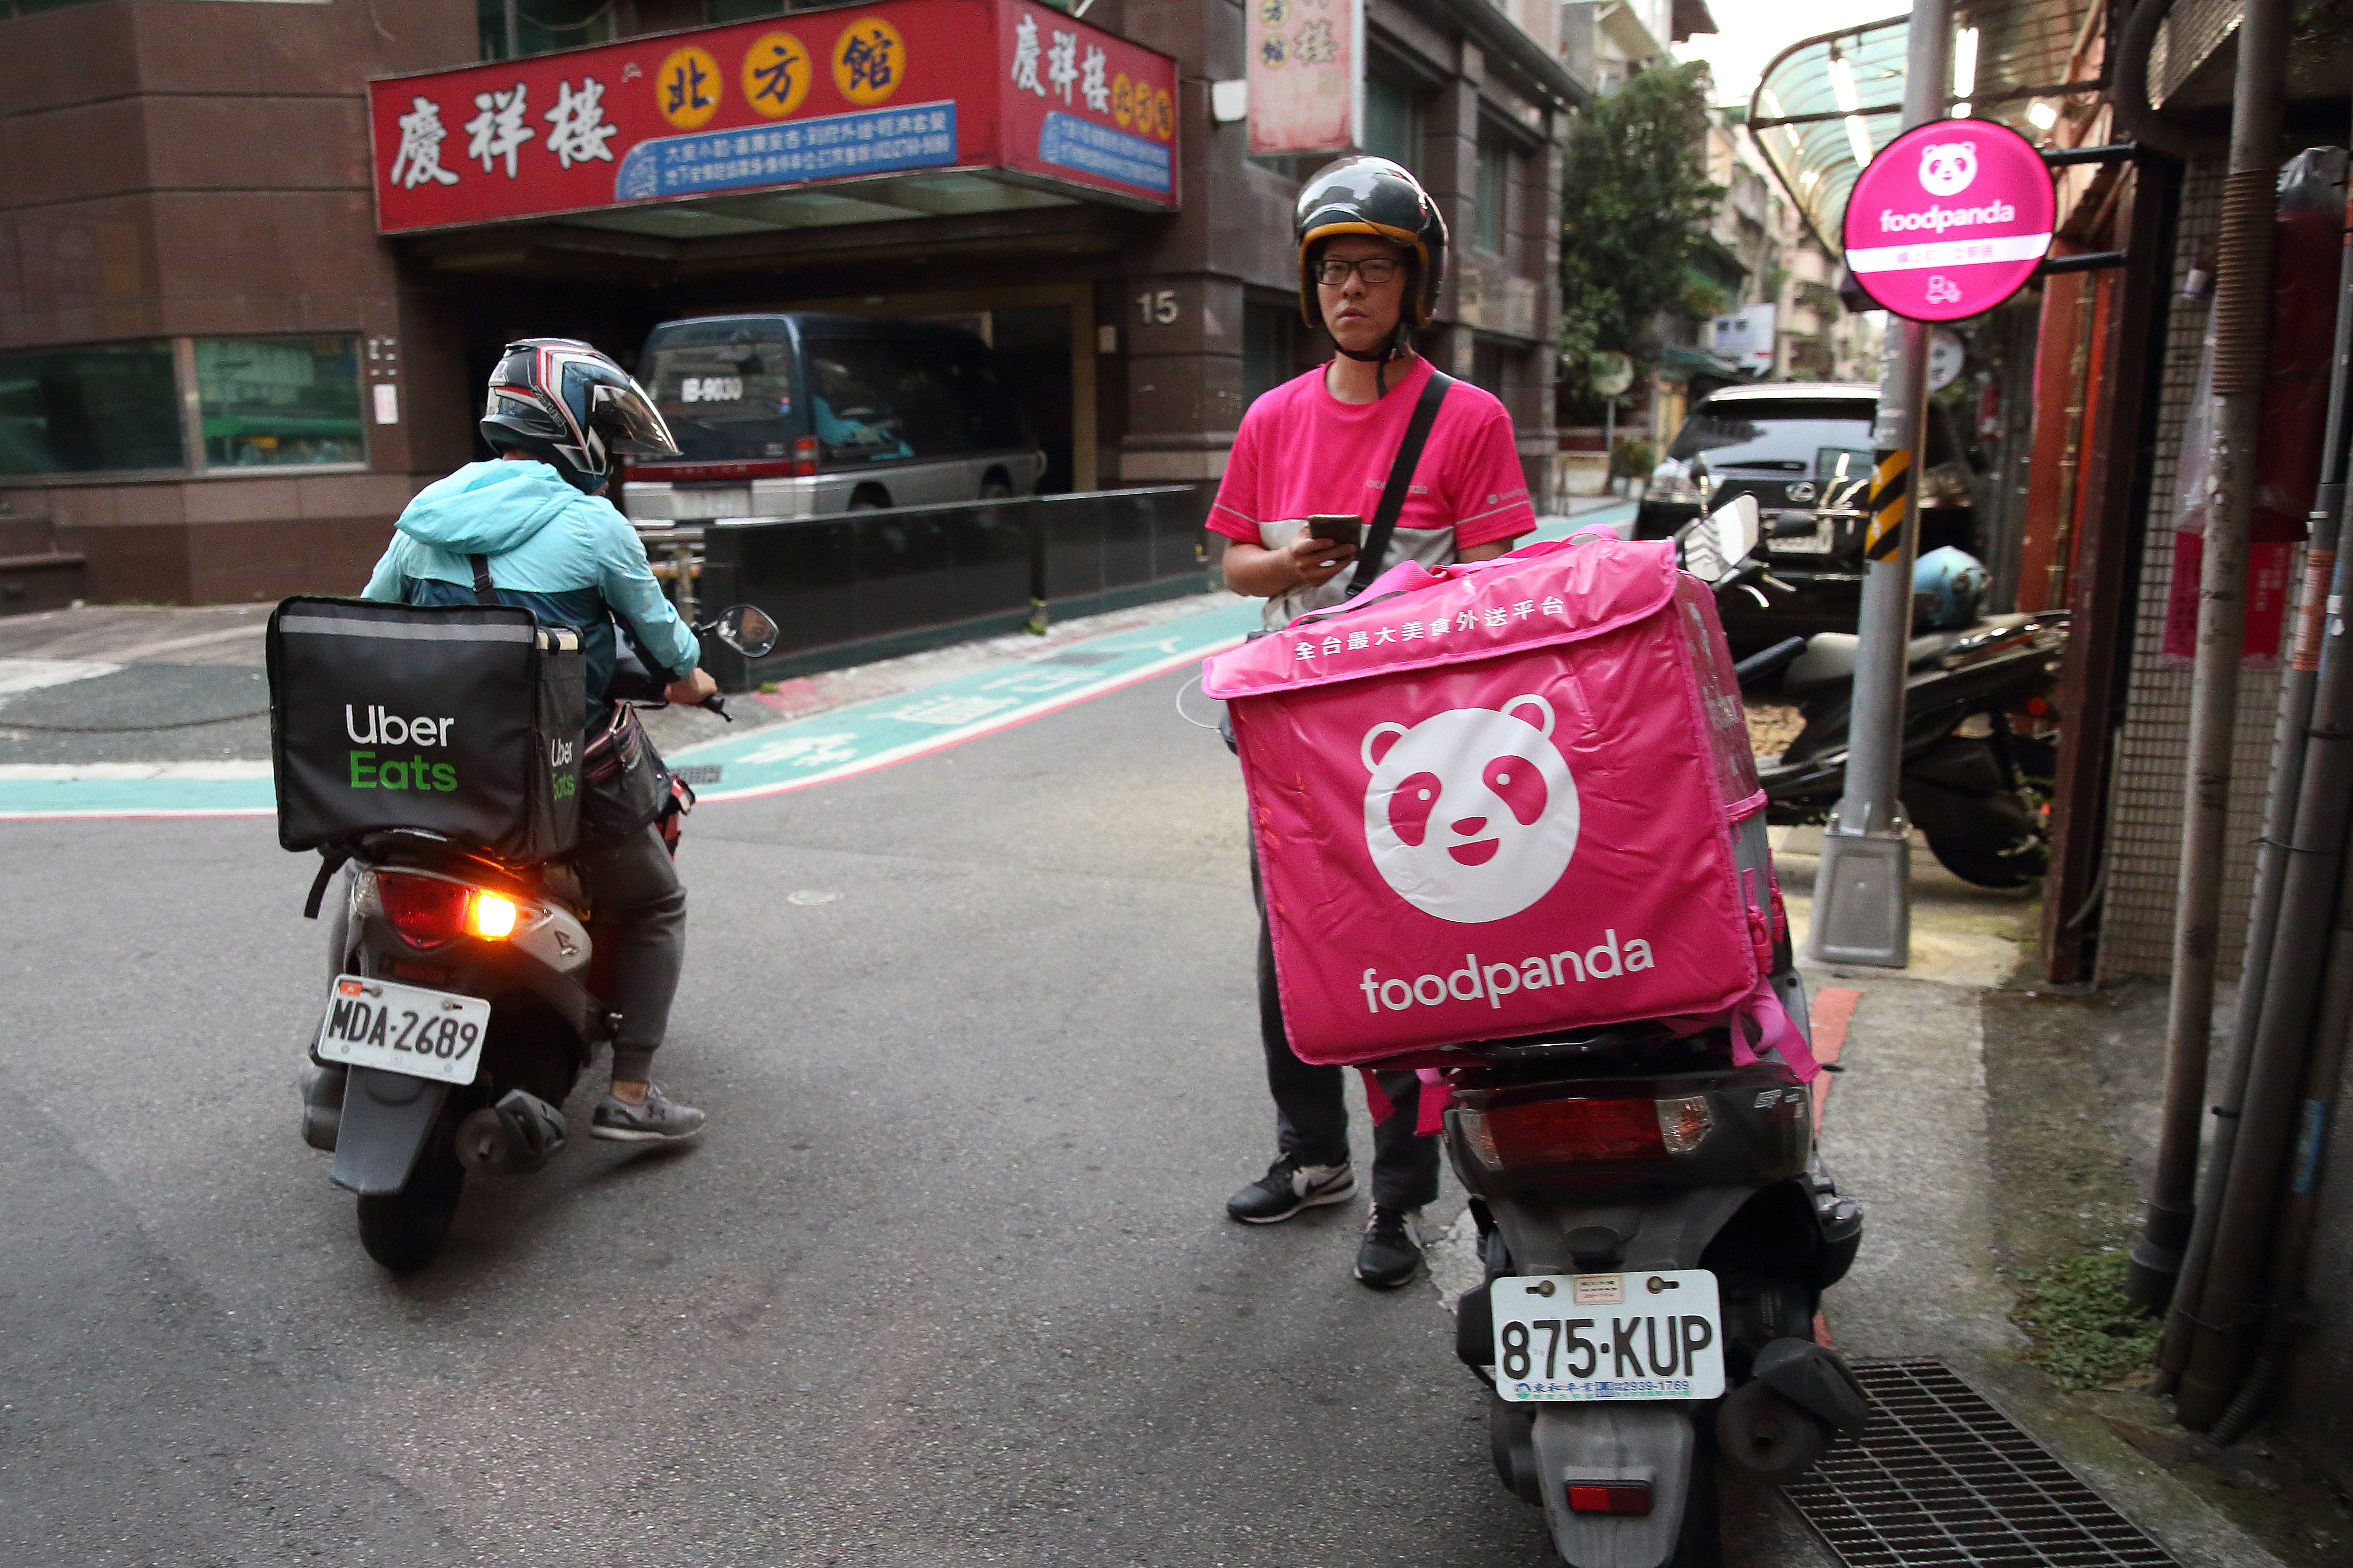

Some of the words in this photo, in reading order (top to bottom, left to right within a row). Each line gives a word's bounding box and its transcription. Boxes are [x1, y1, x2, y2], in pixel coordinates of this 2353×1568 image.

[1012, 13, 1110, 114] 慶祥樓
[391, 76, 618, 190] 慶祥樓
[668, 29, 894, 114] 北方館
[1879, 198, 2016, 234] foodpanda
[1136, 289, 1178, 324] 15
[1294, 595, 1565, 662] 全台最大美食外送平台
[345, 704, 454, 747] Uber
[350, 750, 458, 792] Eats
[551, 737, 573, 768] Uber
[1359, 928, 1655, 1013] foodpanda
[1623, 1380, 1690, 1391] 2939-1769
